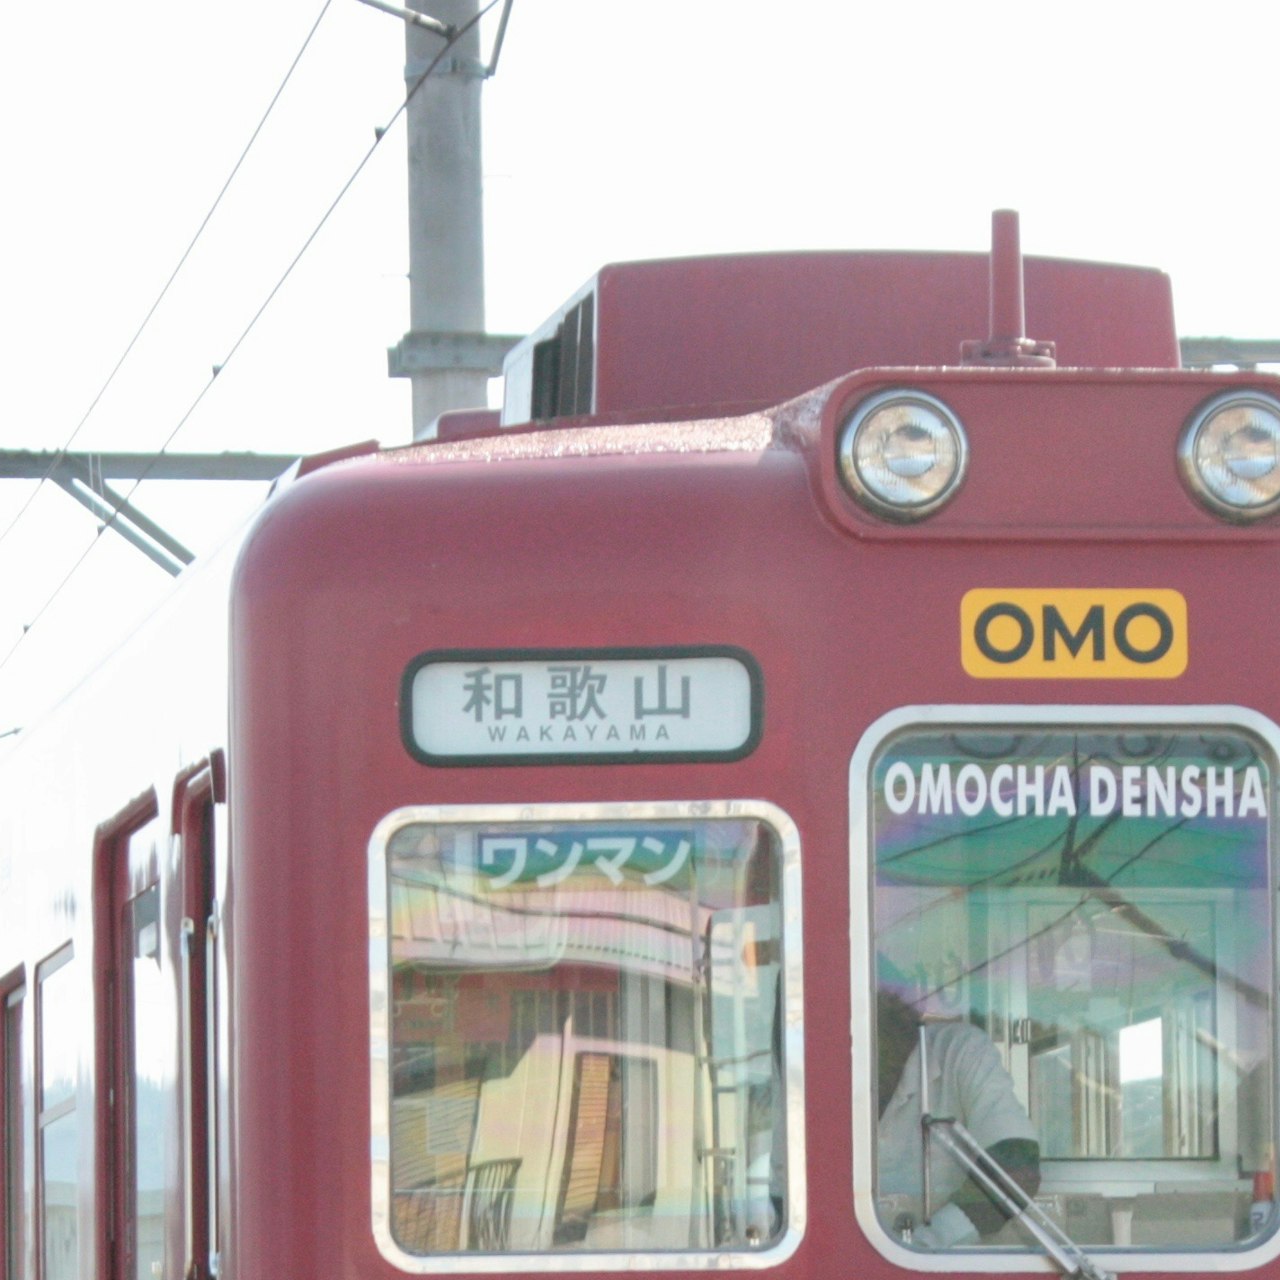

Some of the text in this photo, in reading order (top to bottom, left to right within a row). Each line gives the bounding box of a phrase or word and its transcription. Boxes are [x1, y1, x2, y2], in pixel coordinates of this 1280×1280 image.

[974, 602, 1174, 665] OMO
[462, 664, 691, 723] 和歌山
[488, 724, 671, 743] WAKAYAMA
[884, 761, 1268, 818] OMOCHA DENSHA
[481, 834, 690, 889] ワンマン
